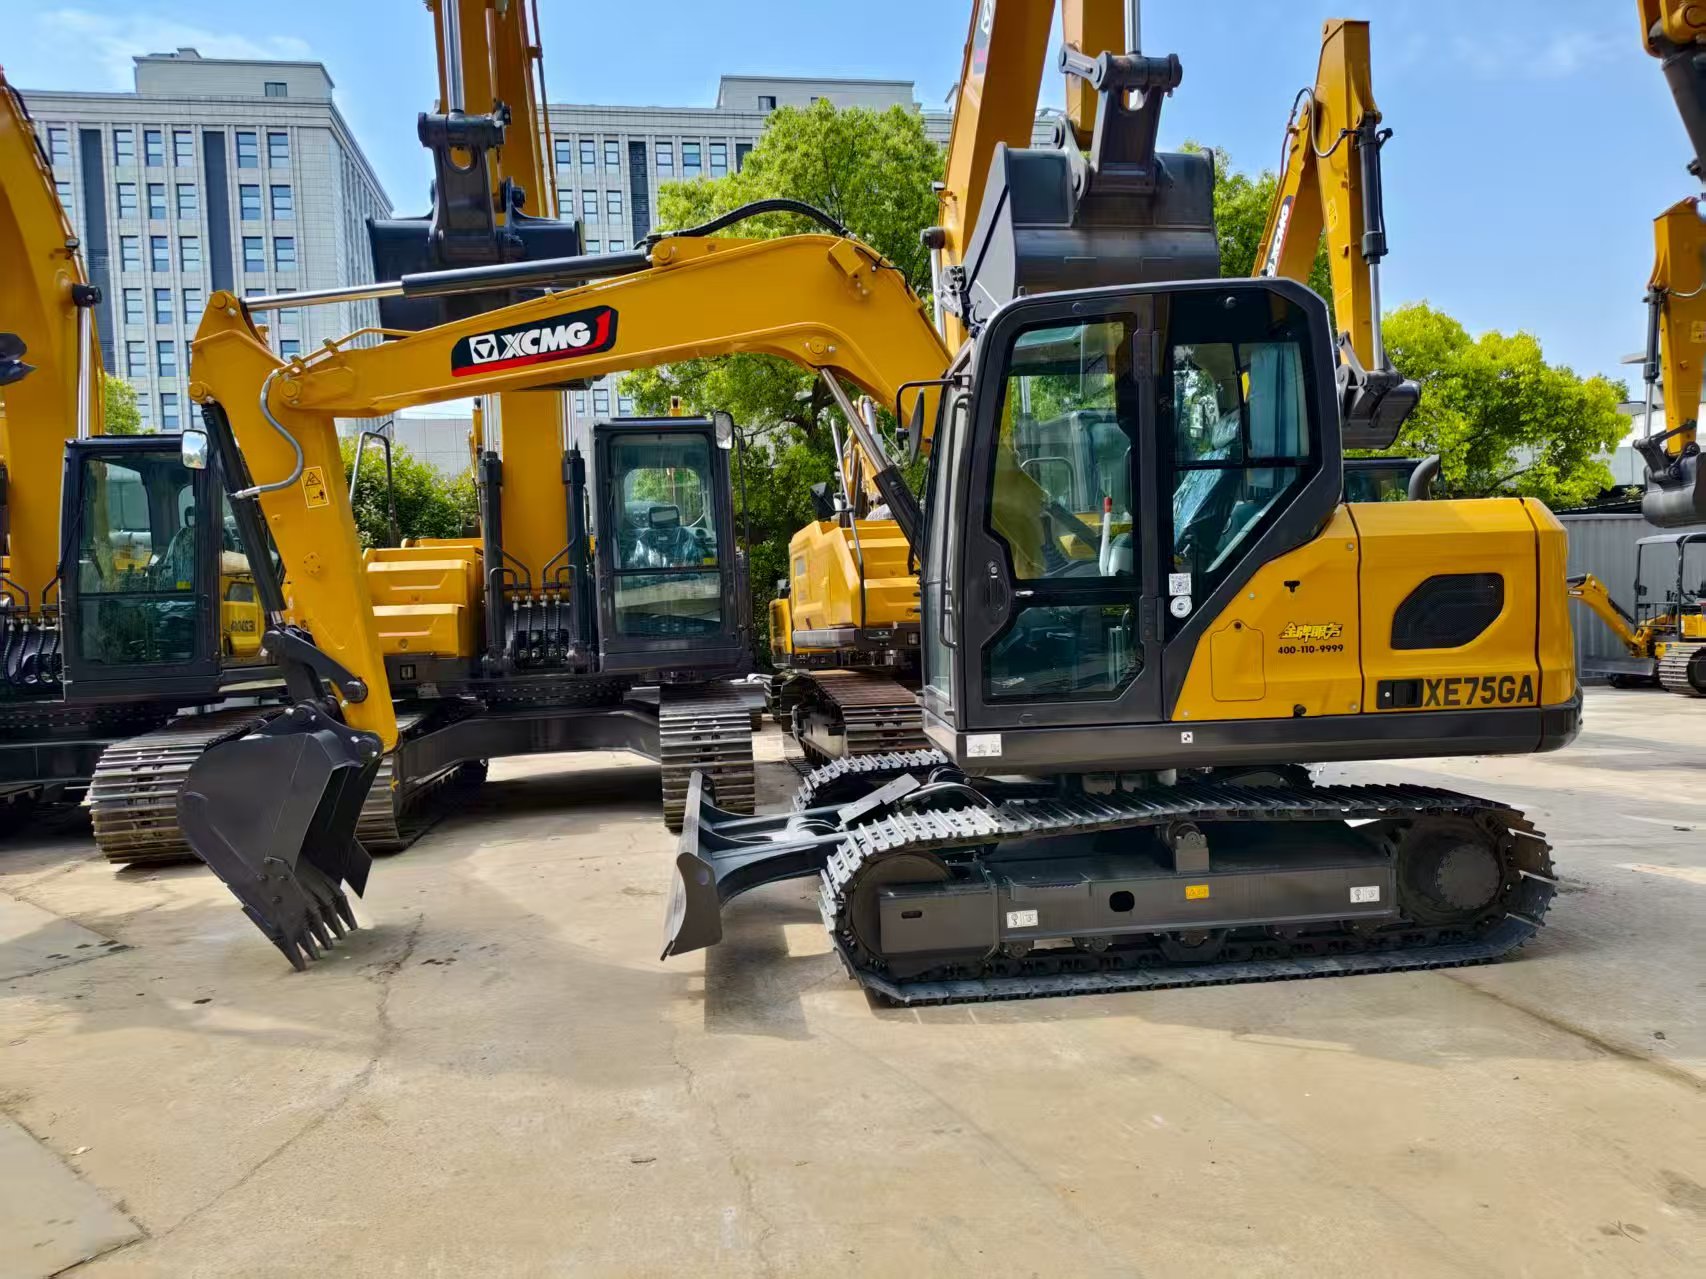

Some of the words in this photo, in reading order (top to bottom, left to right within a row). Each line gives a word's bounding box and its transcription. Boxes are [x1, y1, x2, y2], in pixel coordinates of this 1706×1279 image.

[500, 321, 591, 359] XCMG
[1280, 622, 1343, 643] 金牌服务
[1278, 644, 1344, 655] 400-110-9999
[1424, 674, 1534, 707] XE75GA
